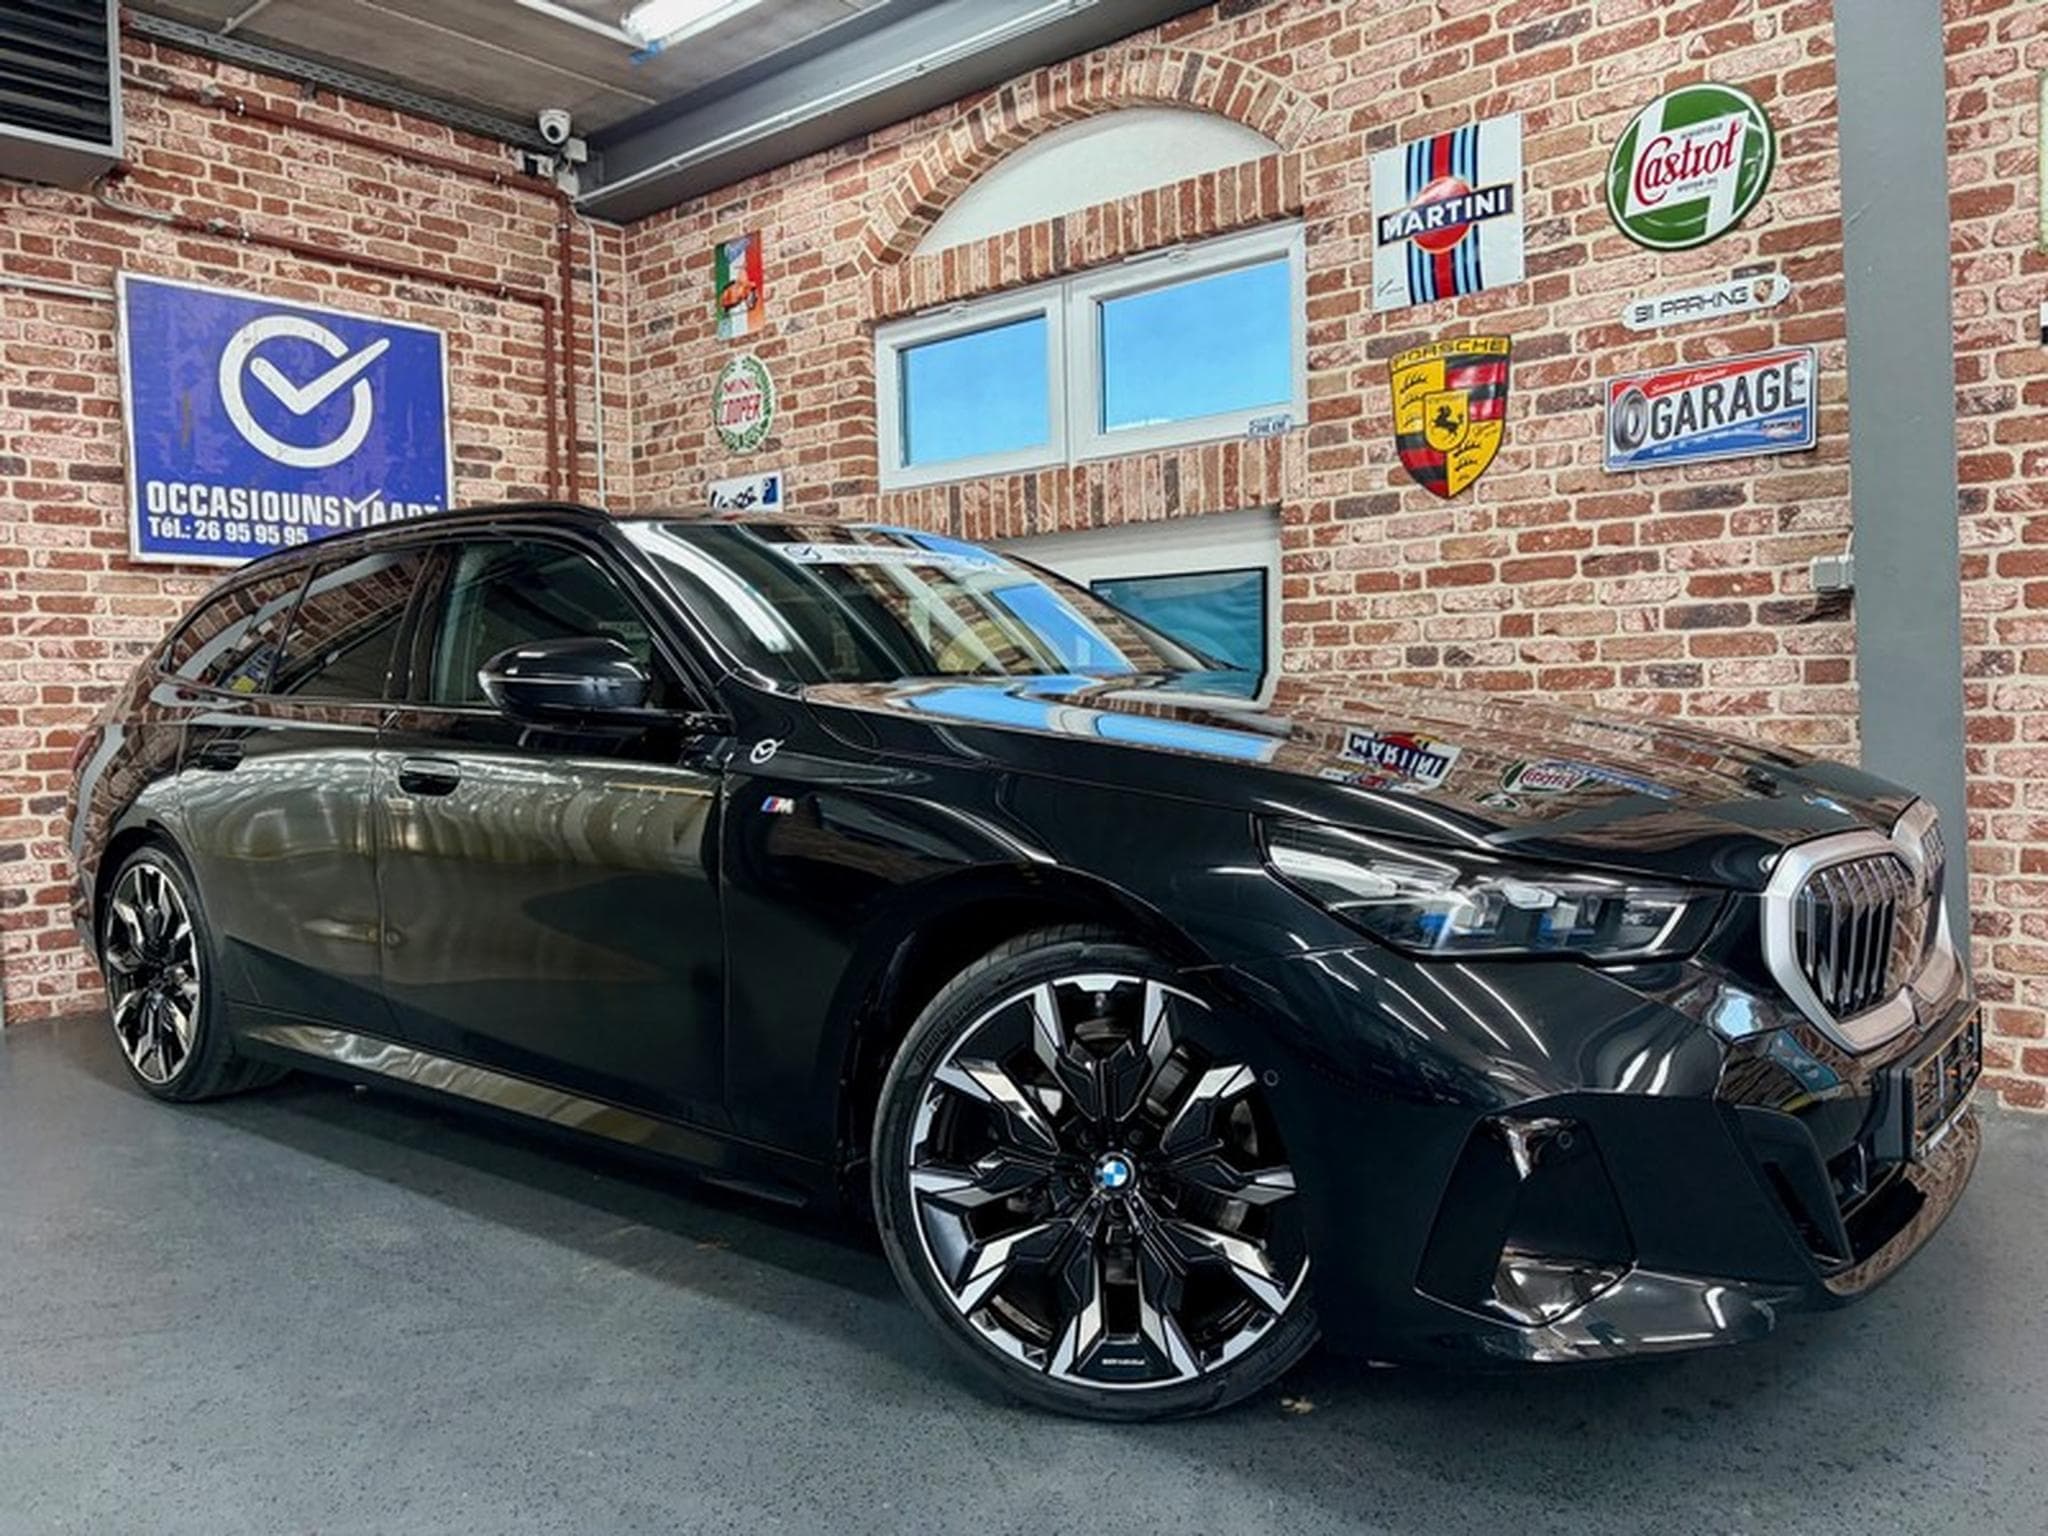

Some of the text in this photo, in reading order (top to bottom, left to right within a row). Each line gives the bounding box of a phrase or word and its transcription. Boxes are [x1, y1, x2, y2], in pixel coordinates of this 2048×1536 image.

[1634, 119, 1741, 206] Castrol
[1382, 188, 1507, 240] MARTINI
[1660, 286, 1749, 318] PARKING
[1393, 338, 1506, 369] PORSCHE
[1650, 361, 1806, 441] GARAGE
[148, 516, 309, 546] Tél.: 26 95 95 95
